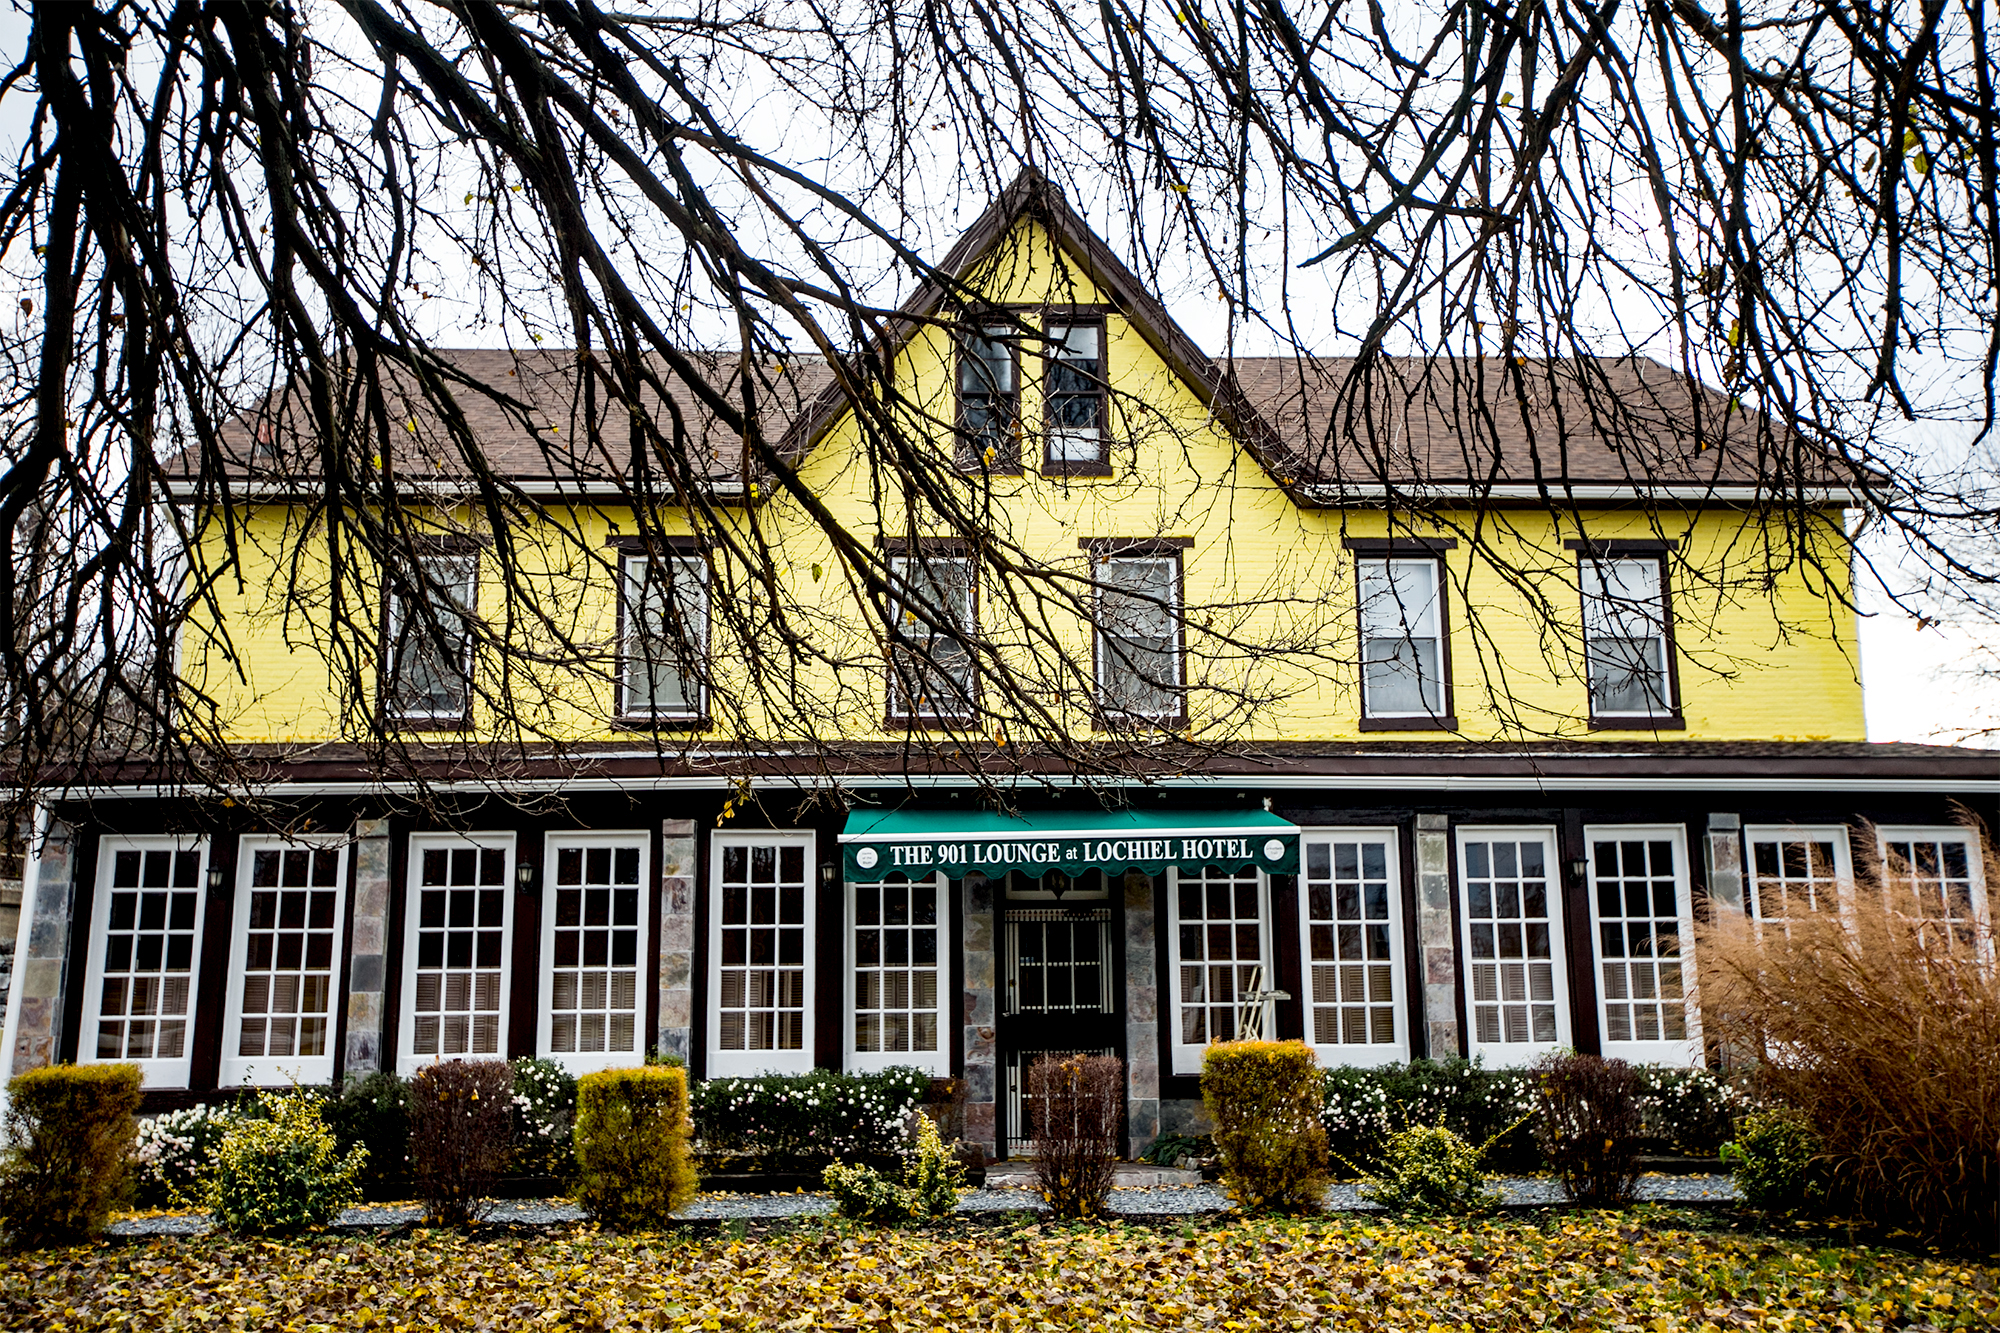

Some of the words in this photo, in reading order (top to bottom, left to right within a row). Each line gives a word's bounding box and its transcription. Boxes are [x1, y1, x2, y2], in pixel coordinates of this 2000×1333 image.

[890, 845, 933, 866] THE
[938, 843, 967, 865] 901
[973, 842, 1060, 864] LOUNGE
[1065, 847, 1078, 860] at
[1083, 840, 1177, 862] LOCHIEL
[1182, 838, 1254, 860] HOTEL
